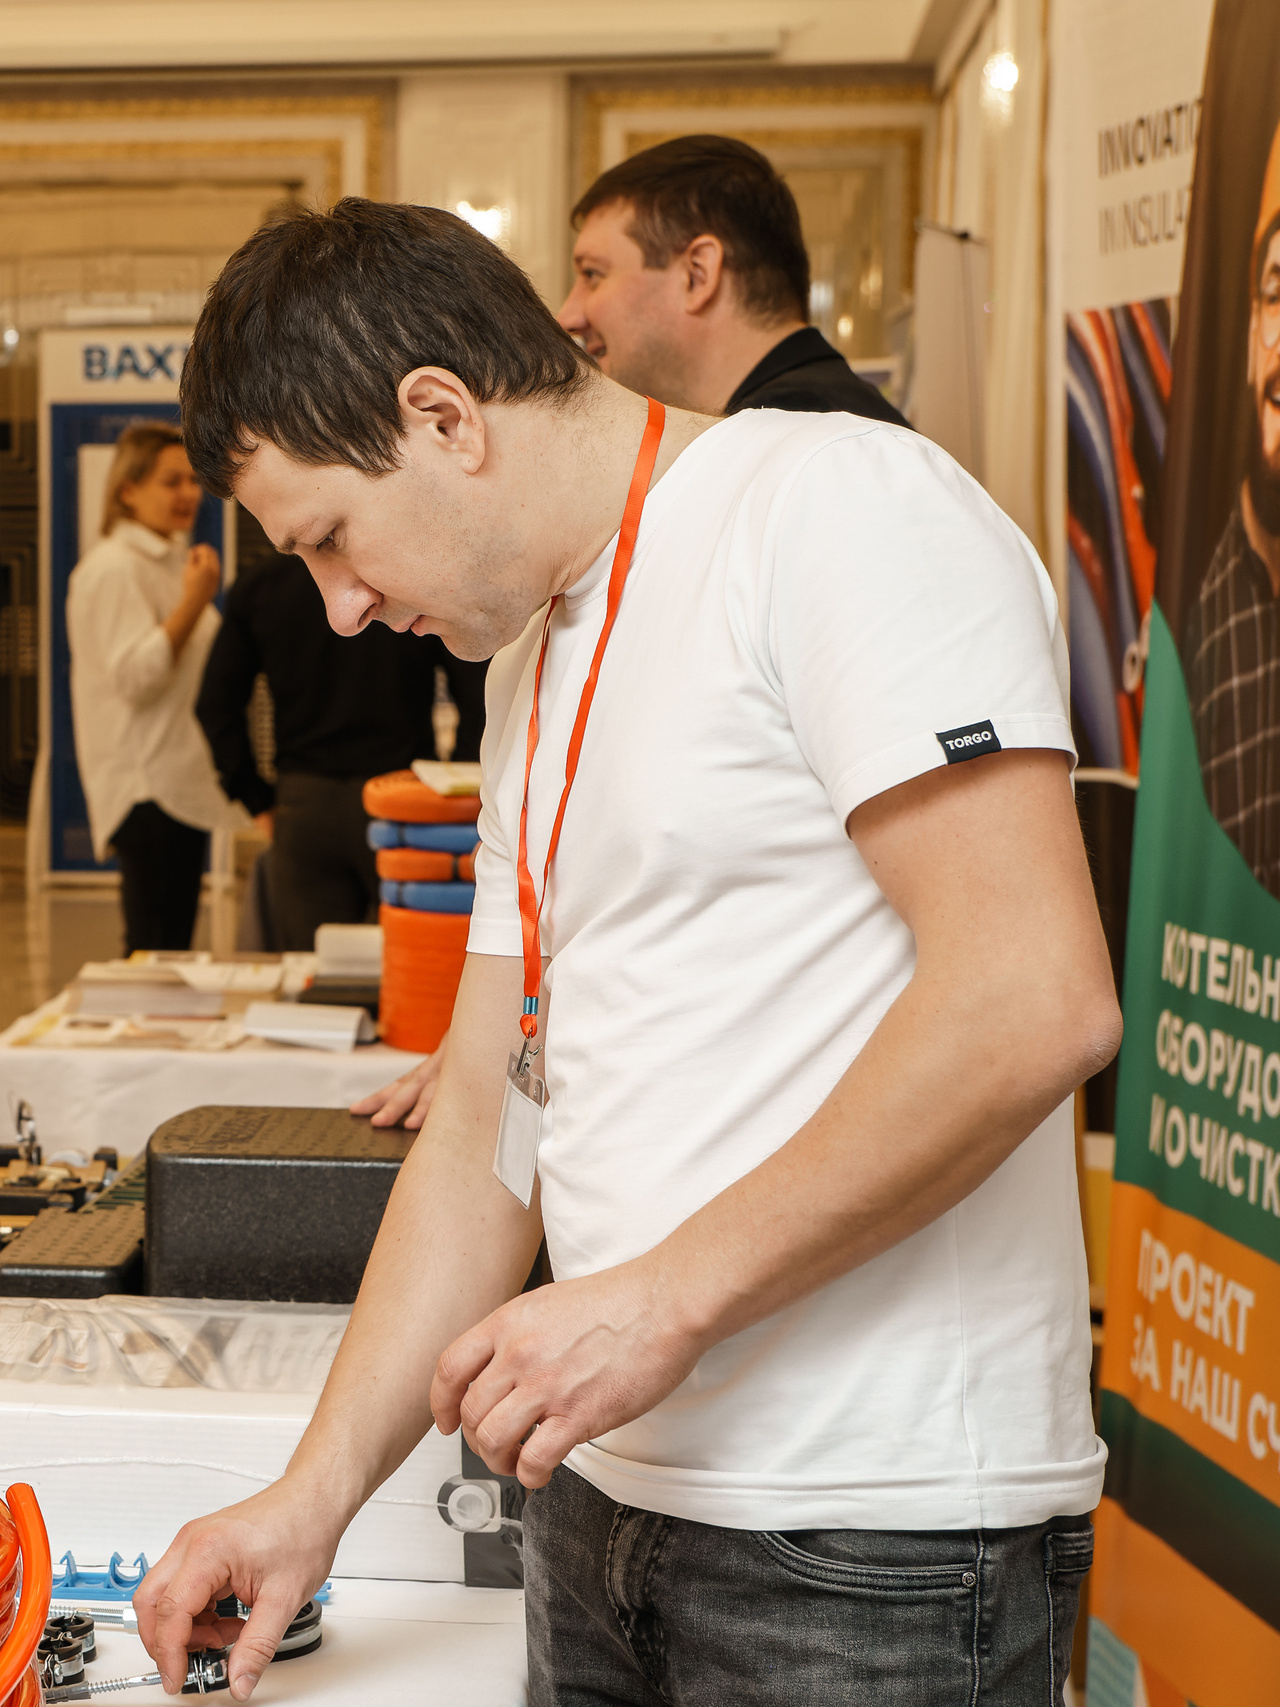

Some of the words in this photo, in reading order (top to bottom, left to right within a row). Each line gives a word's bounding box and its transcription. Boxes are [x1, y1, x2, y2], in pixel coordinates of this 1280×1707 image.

[1118, 186, 1191, 251] INSULA
[945, 730, 992, 750] TORGO
[1154, 1008, 1280, 1123] ОБОРУДО
[1136, 1228, 1255, 1356] ПРОЕКТ
[1131, 1313, 1162, 1392] ЗА
[1171, 1340, 1241, 1443] НАШ
